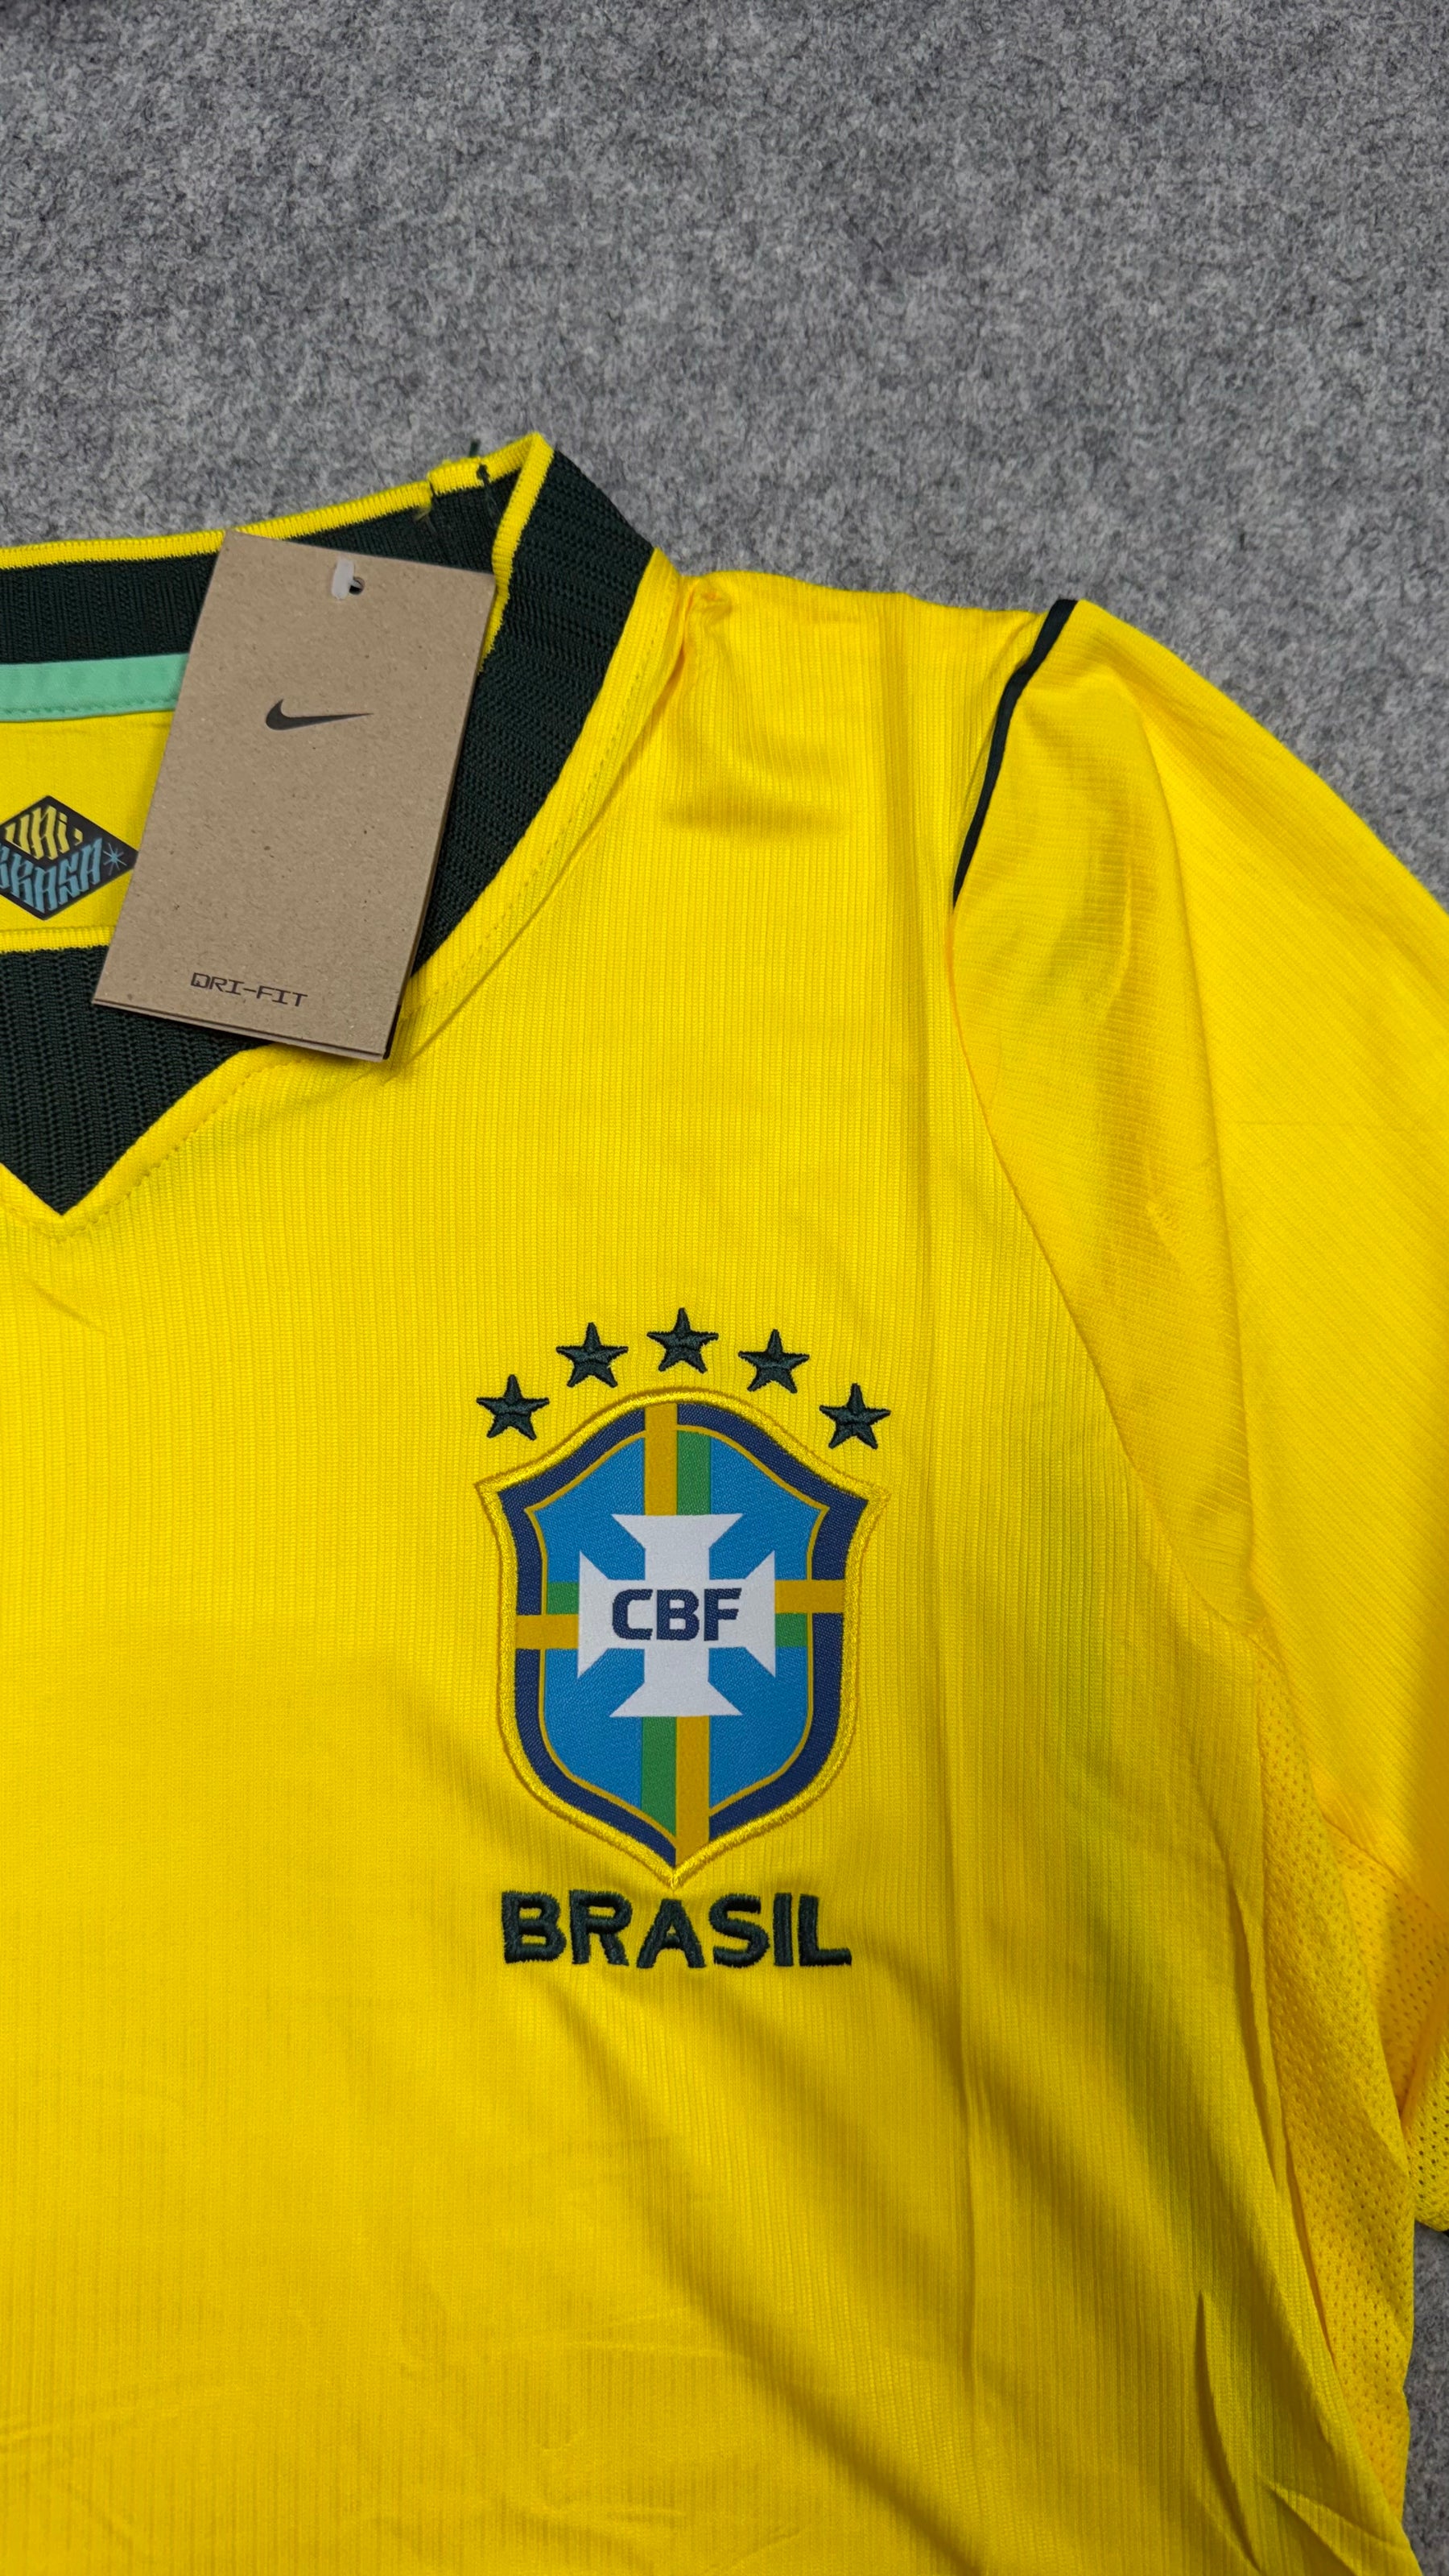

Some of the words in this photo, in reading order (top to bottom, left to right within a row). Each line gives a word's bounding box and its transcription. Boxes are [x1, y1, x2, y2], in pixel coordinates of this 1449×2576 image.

[191, 972, 308, 1006] DRI-FIT
[613, 1587, 742, 1641] CBF
[502, 1889, 852, 1968] BRASIL
